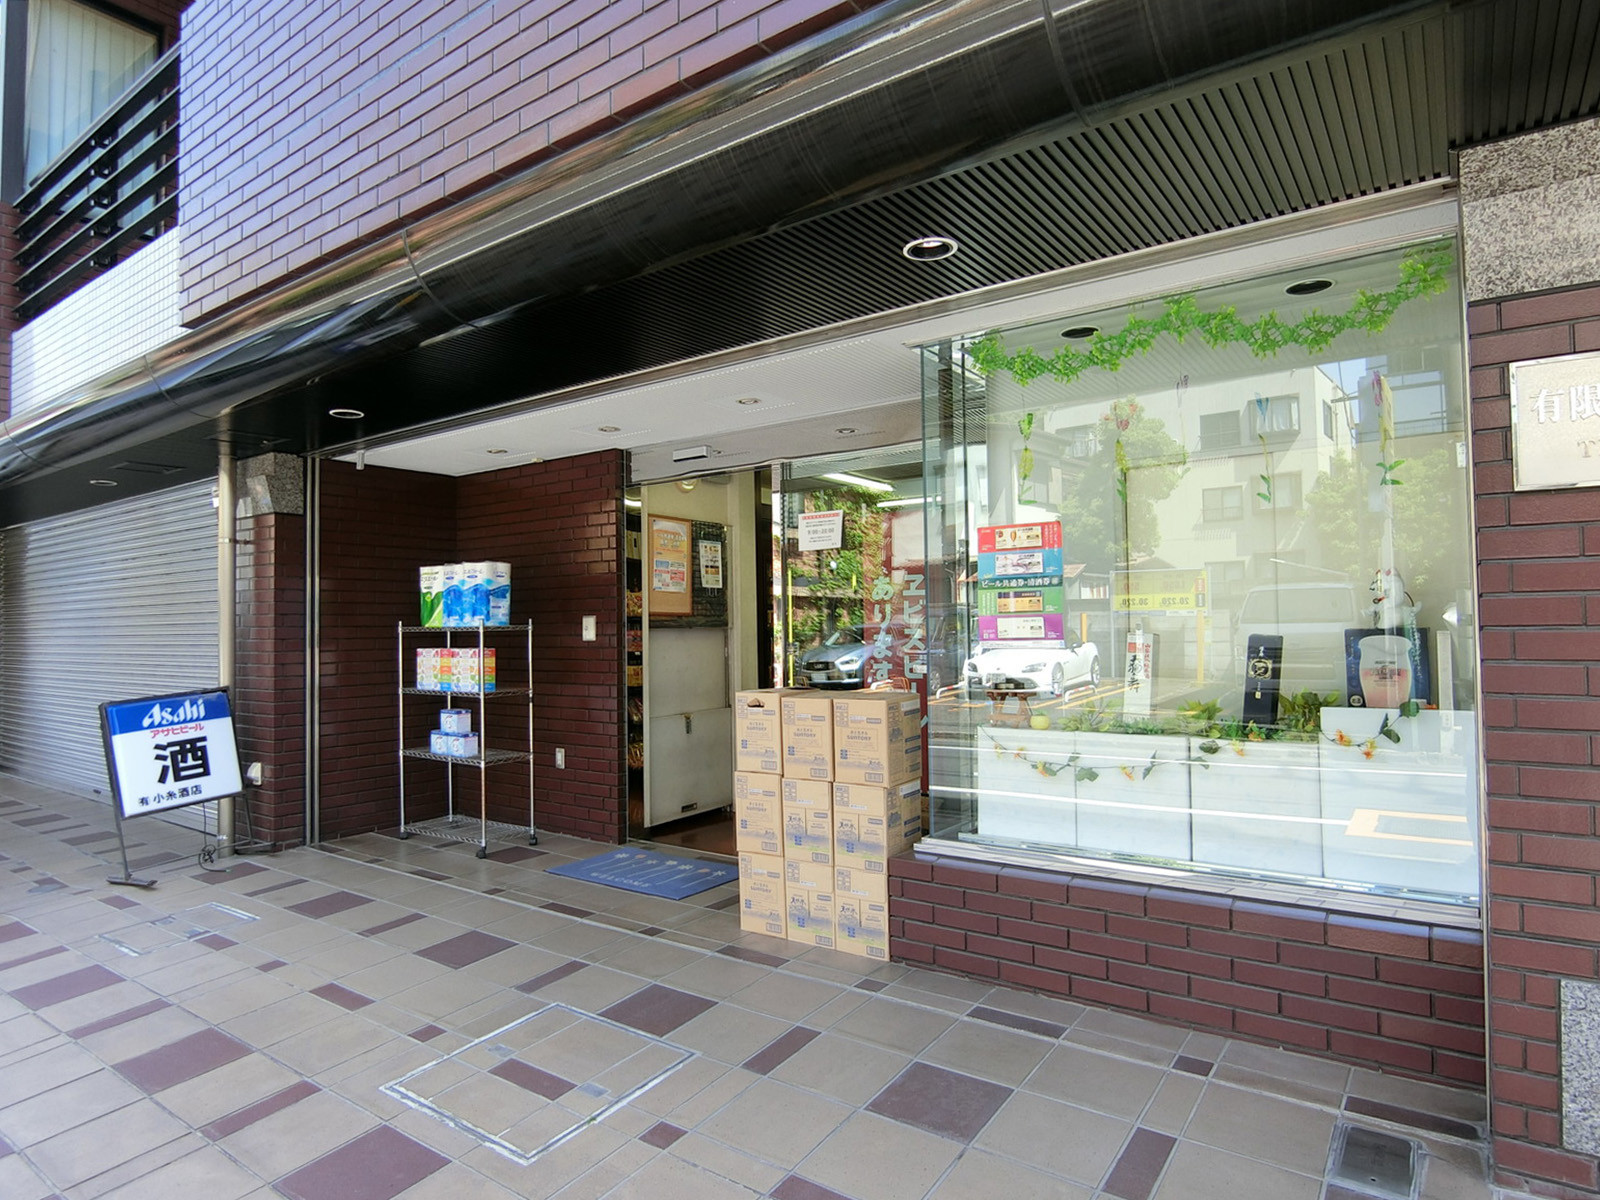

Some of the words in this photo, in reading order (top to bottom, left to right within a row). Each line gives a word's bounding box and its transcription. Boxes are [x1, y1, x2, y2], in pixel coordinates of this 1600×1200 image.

[1577, 440, 1600, 458] T
[872, 575, 894, 681] あります
[142, 698, 206, 728] Asahi
[150, 723, 204, 739] アサヒビール
[153, 736, 211, 784] 酒
[153, 785, 202, 804] 小糸酒店
